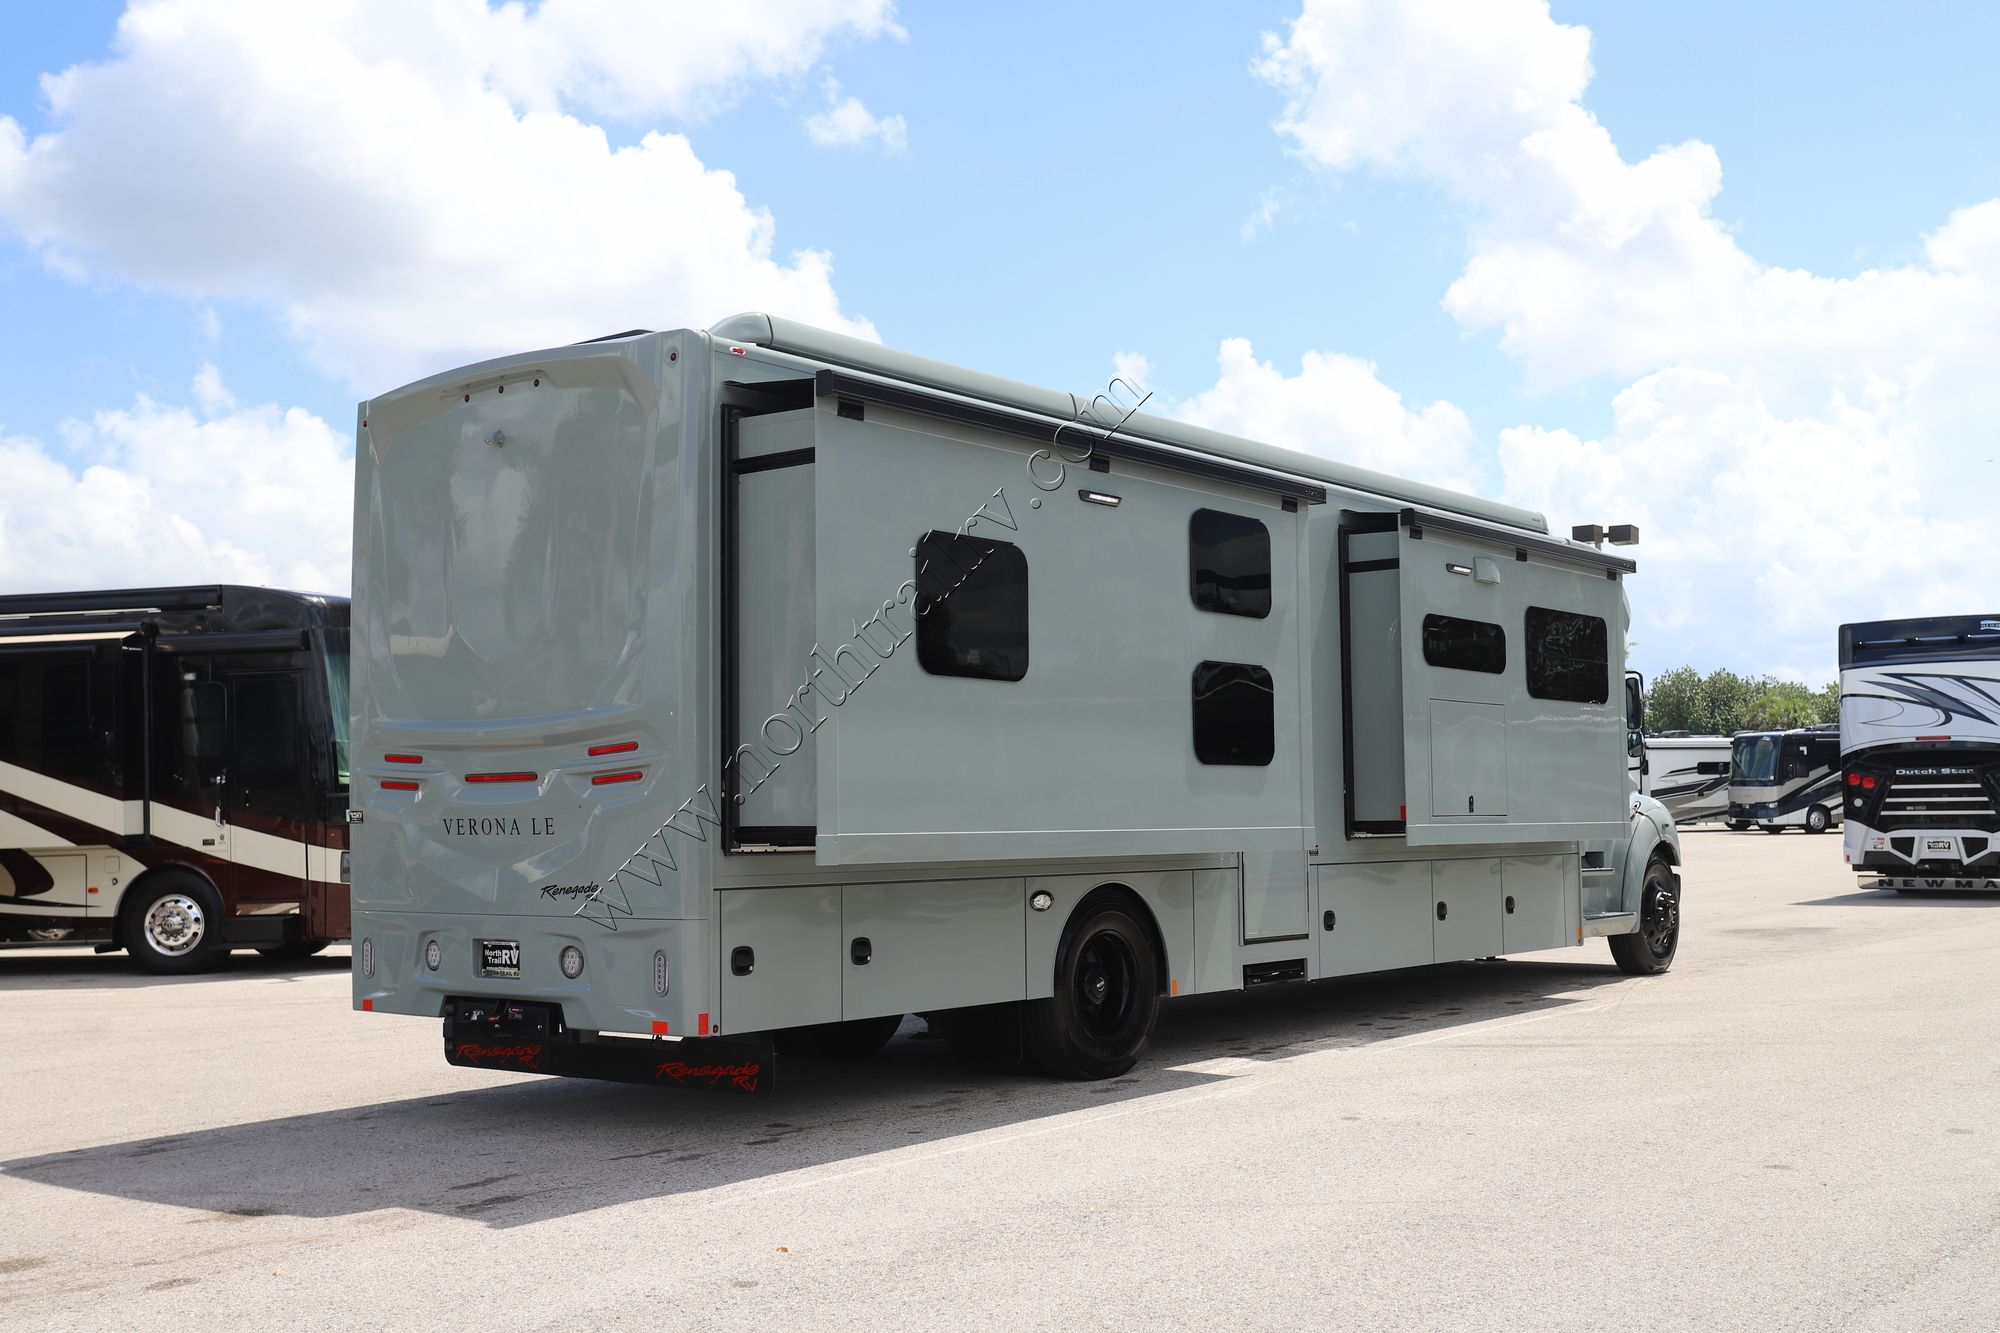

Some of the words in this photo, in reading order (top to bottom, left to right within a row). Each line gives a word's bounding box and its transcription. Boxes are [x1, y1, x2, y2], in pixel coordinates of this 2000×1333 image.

[443, 818, 521, 836] VERONA
[532, 818, 555, 835] LE
[540, 881, 599, 901] Renegade
[484, 949, 502, 957] North
[502, 949, 519, 965] RV
[487, 956, 502, 964] Trail
[454, 1043, 544, 1064] Renegade
[520, 1055, 541, 1070] RV
[656, 1061, 760, 1084] Renegade
[732, 1076, 758, 1092] RV
